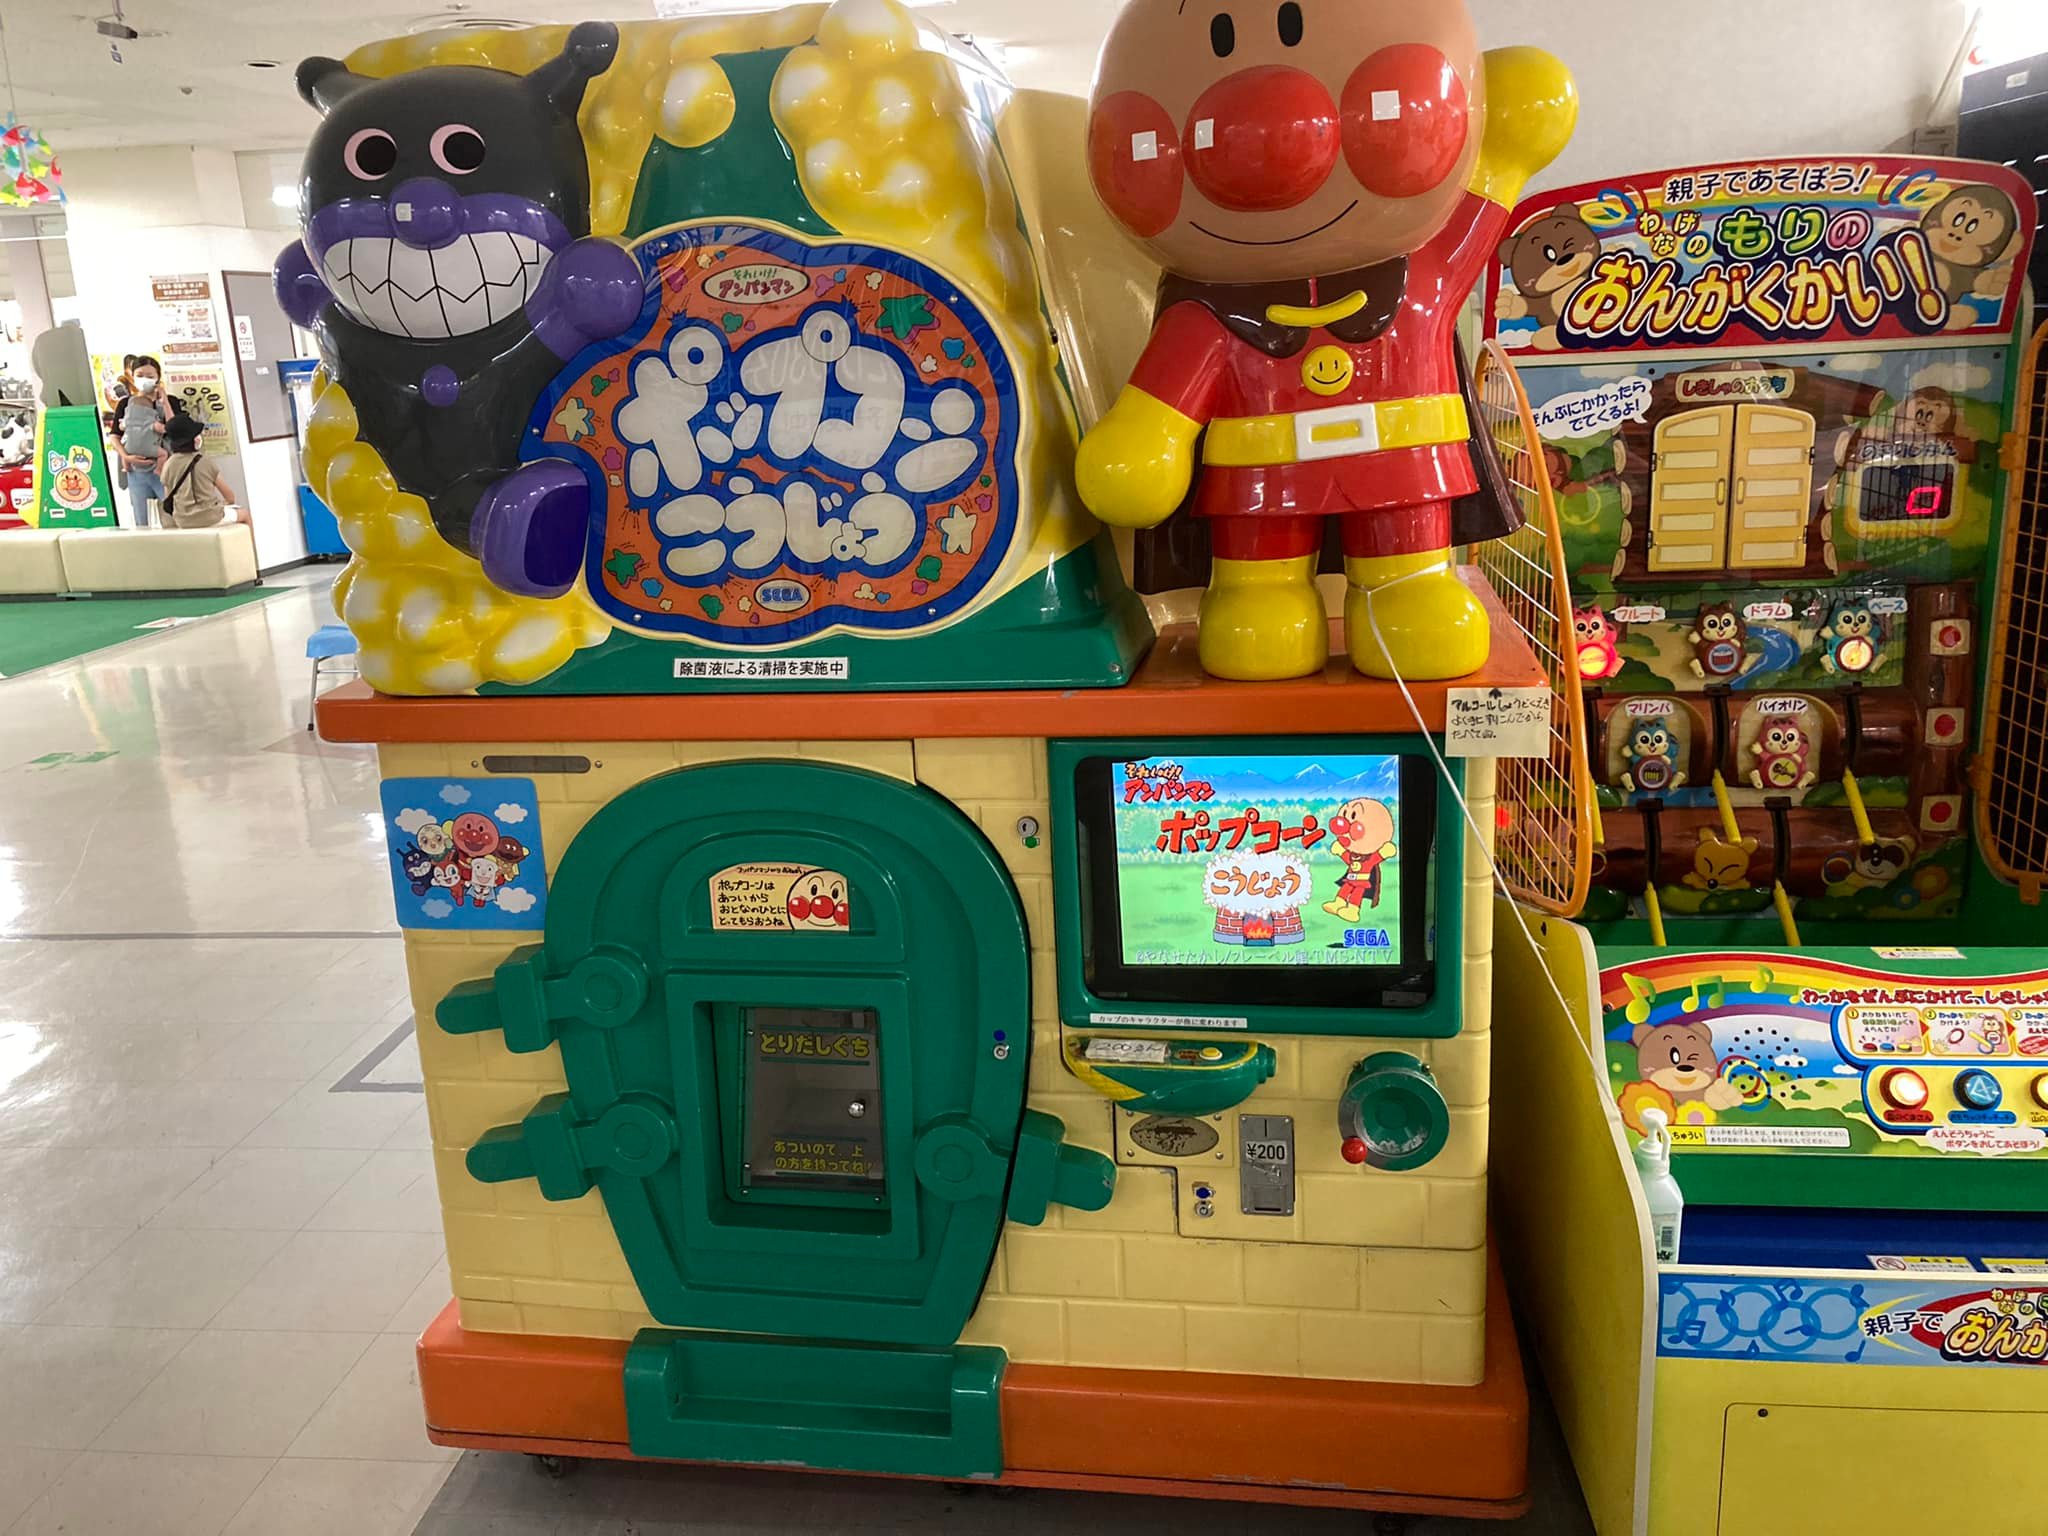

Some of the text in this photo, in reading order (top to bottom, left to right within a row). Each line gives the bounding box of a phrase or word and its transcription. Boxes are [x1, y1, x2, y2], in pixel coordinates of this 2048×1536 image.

[1665, 167, 1872, 204] 親子であそぼう!
[1720, 206, 1873, 256] もりの
[719, 279, 794, 298] アンパンマン
[1571, 234, 1945, 333] おんがくかい!
[1682, 376, 1786, 396] しきしゃのおうち
[618, 310, 978, 497] ポップコーン
[1569, 402, 1640, 431] でてくるよ!
[656, 472, 916, 577] こうじょう
[762, 588, 803, 602] SEGA
[1616, 608, 1661, 620] フルート
[1750, 606, 1787, 617] ドラム
[1871, 600, 1905, 611] ベース
[680, 661, 844, 676] 除菌液による清掃を実施中
[1628, 703, 1670, 713] マリンバ
[1757, 700, 1807, 712] バイオリン
[1124, 779, 1215, 803] アンパンマン
[1156, 807, 1326, 854] ポップコーン
[718, 880, 775, 891] ポップコーンは
[1211, 866, 1301, 898] こうじょう
[718, 894, 769, 903] あついから
[720, 905, 787, 914] おとなのひとに
[720, 916, 785, 926] とってもらおうね
[1344, 929, 1390, 946] SEGA
[760, 1033, 870, 1057] とりだしぐち
[1246, 1144, 1285, 1160] ¥200
[1864, 1312, 1944, 1337] 親子で
